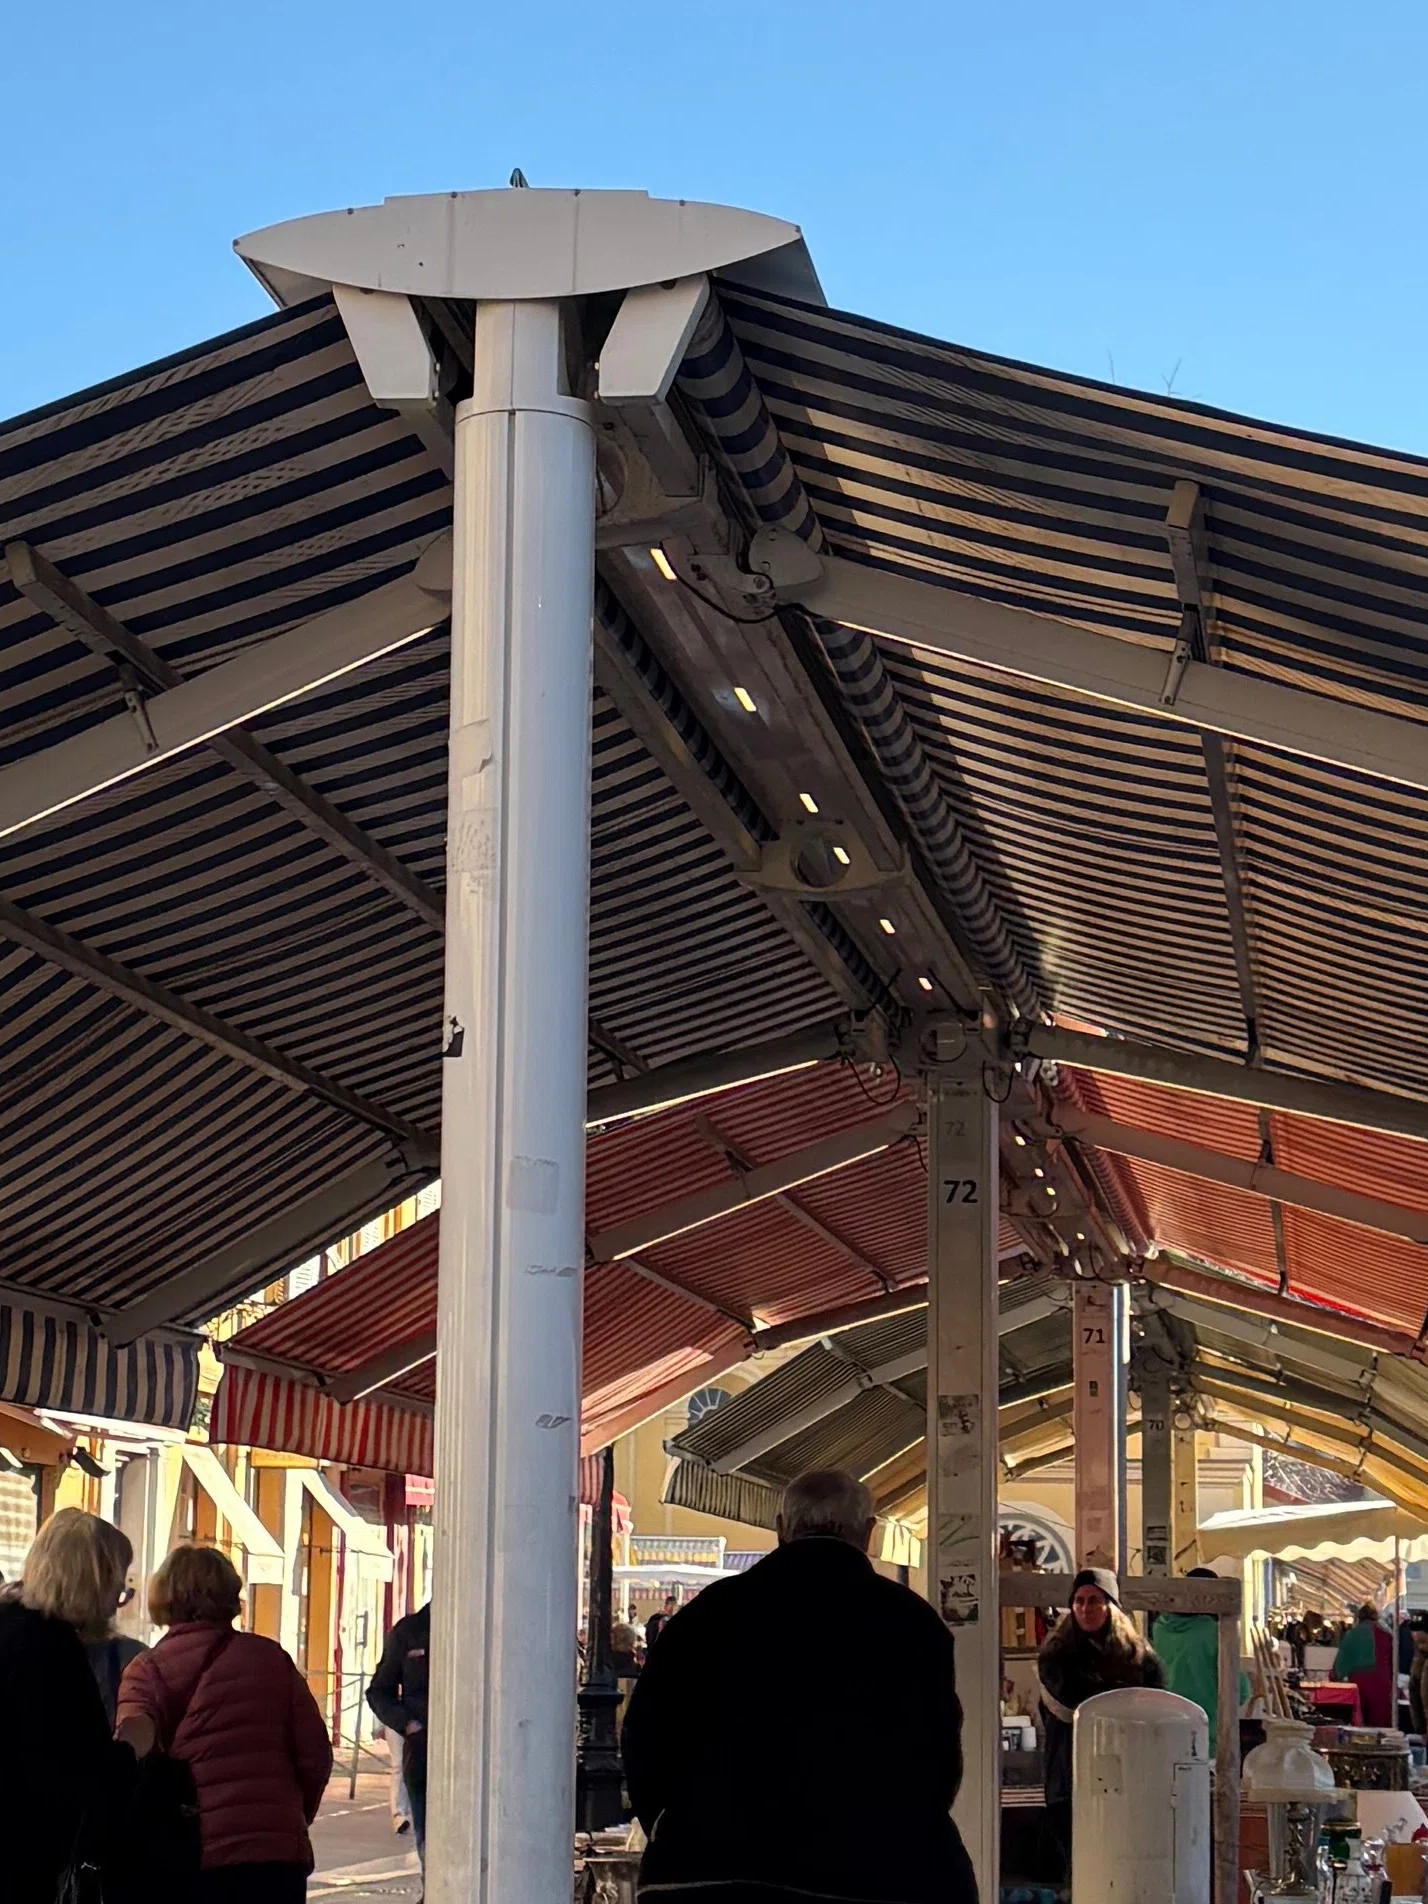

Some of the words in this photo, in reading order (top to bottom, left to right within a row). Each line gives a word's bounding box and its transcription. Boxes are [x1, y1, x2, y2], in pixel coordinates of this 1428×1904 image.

[944, 1180, 978, 1204] 72
[1083, 1327, 1106, 1345] 71
[1148, 1419, 1164, 1431] 70
